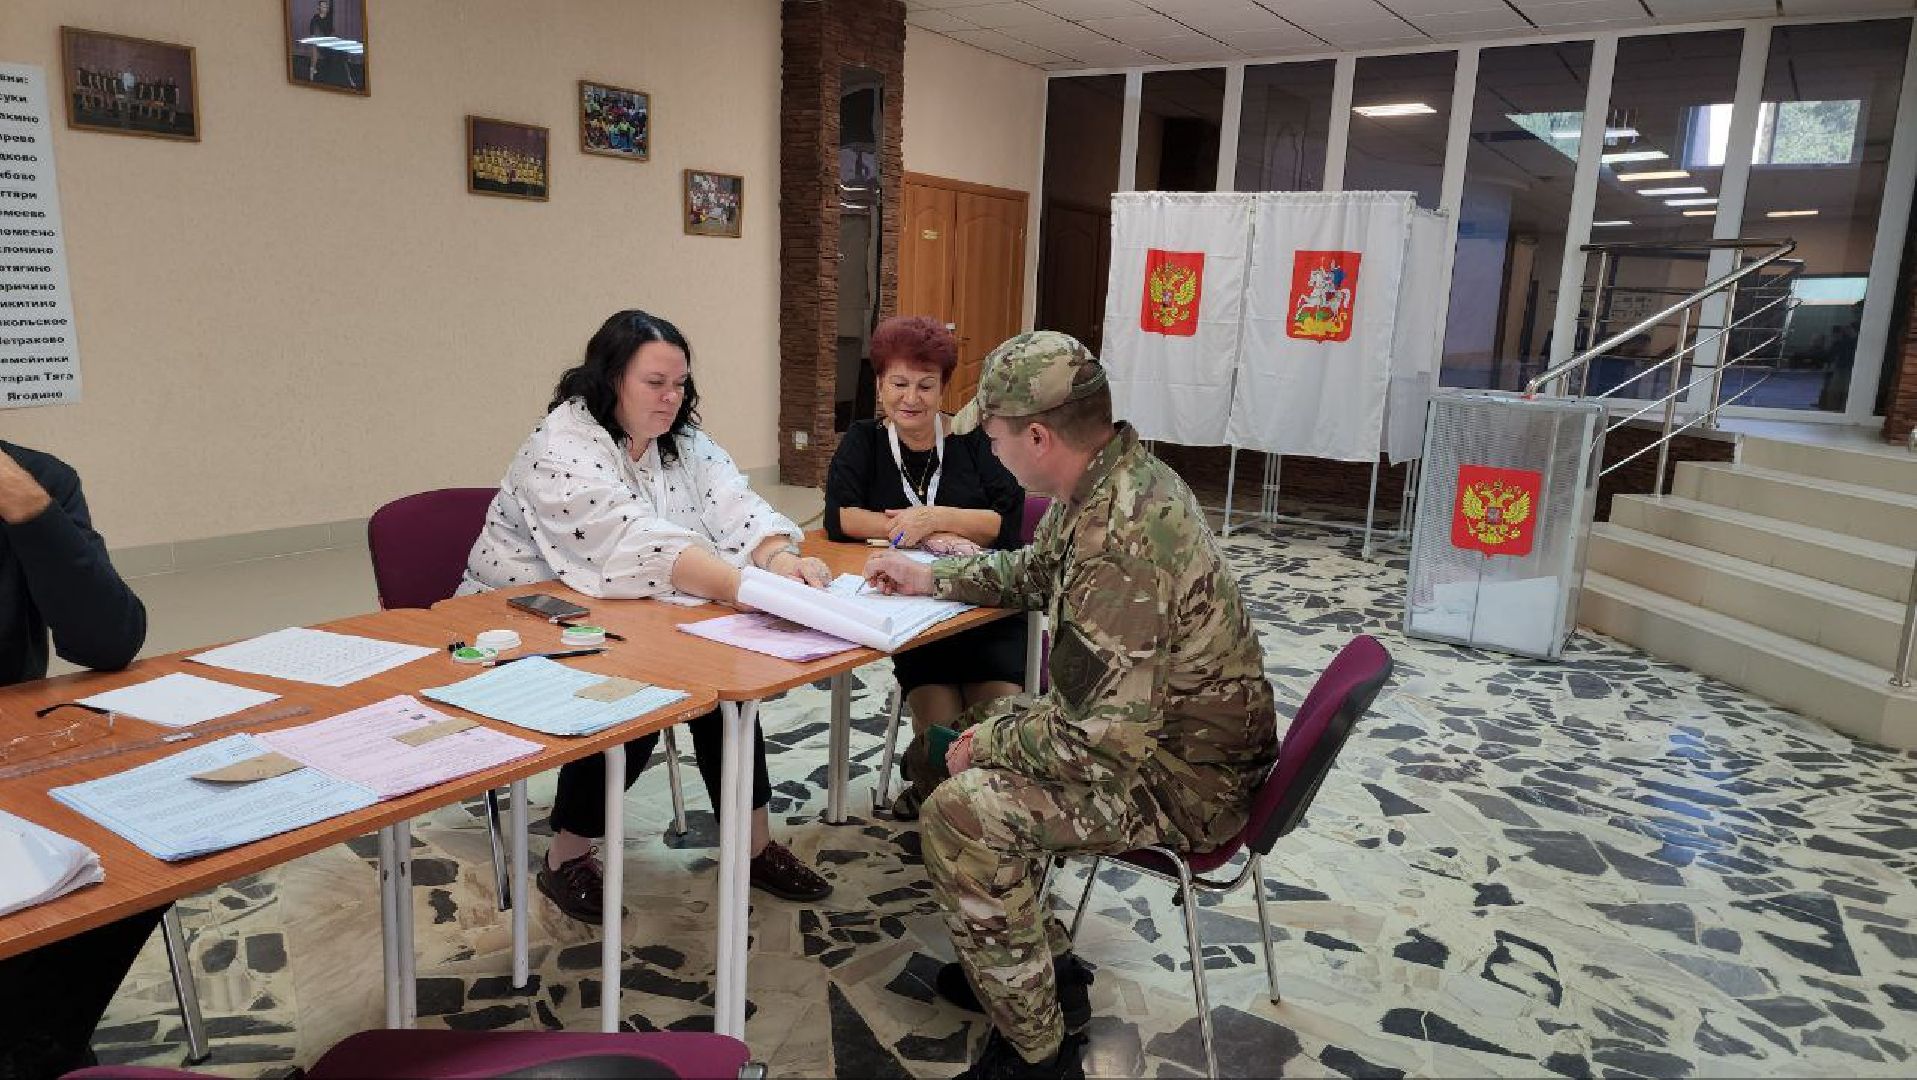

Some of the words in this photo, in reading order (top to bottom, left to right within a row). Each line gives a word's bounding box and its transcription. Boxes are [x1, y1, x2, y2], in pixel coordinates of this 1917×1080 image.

[0, 246, 54, 254] лонино
[0, 336, 65, 346] етраково
[0, 374, 41, 385] тарая
[43, 371, 74, 381] Тяга
[7, 392, 63, 402] Ягодино
